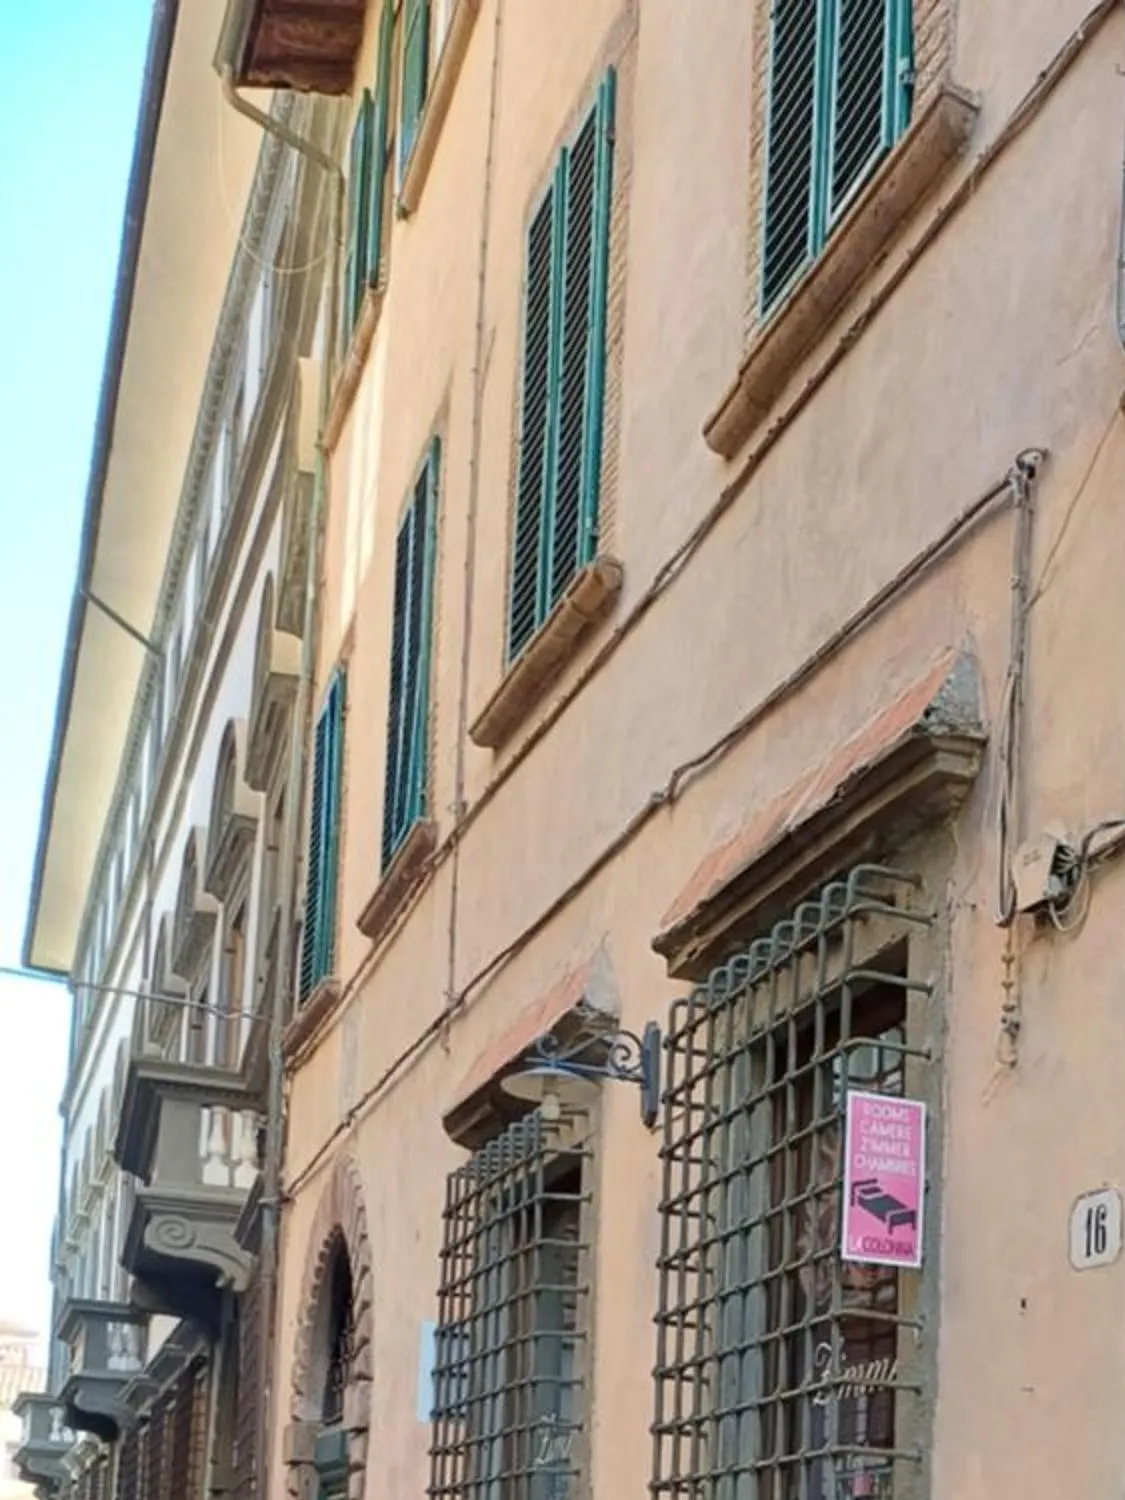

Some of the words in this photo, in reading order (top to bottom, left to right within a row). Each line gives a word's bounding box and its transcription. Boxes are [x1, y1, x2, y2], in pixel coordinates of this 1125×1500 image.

[860, 1119, 912, 1139] CAMERE
[860, 1136, 911, 1156] ZIMMER
[1085, 1203, 1108, 1259] 16
